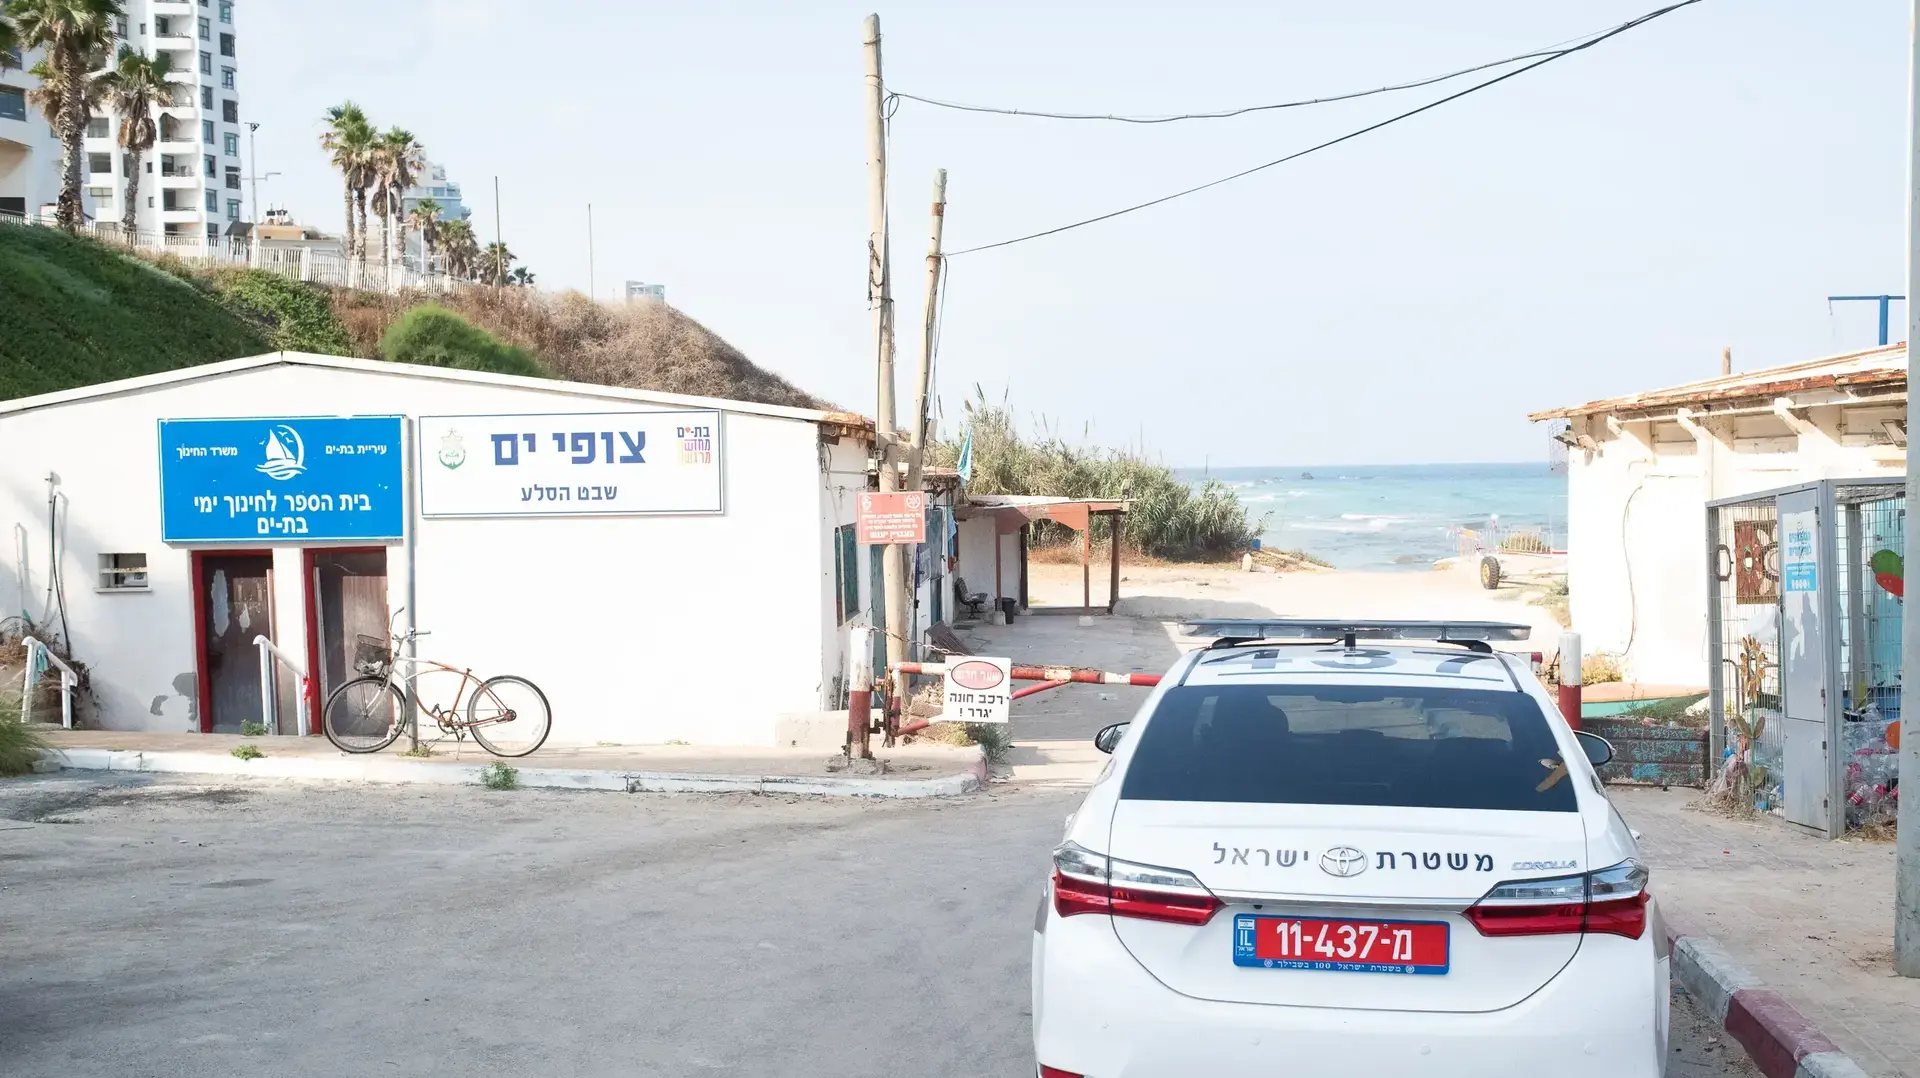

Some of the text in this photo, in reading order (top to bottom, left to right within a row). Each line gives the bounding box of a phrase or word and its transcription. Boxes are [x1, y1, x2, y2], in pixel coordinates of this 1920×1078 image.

[176, 446, 238, 459] משרד החינוך
[325, 444, 388, 456] עיריית בת-ים
[491, 431, 647, 466] צופי ים
[521, 483, 618, 502] שבט הסלע
[194, 490, 372, 518] בית הספר לחינוך ימי
[257, 516, 309, 535] בת-ים
[949, 693, 1004, 705] רכב חונה
[967, 708, 992, 718] יגרר
[1212, 842, 1495, 873] משטרת ישראל
[1511, 859, 1578, 871] COROLLA
[1240, 929, 1252, 946] IL
[1277, 960, 1309, 969] בשבילך
[1337, 962, 1365, 970] ישראל
[1370, 965, 1401, 973] משטרת
